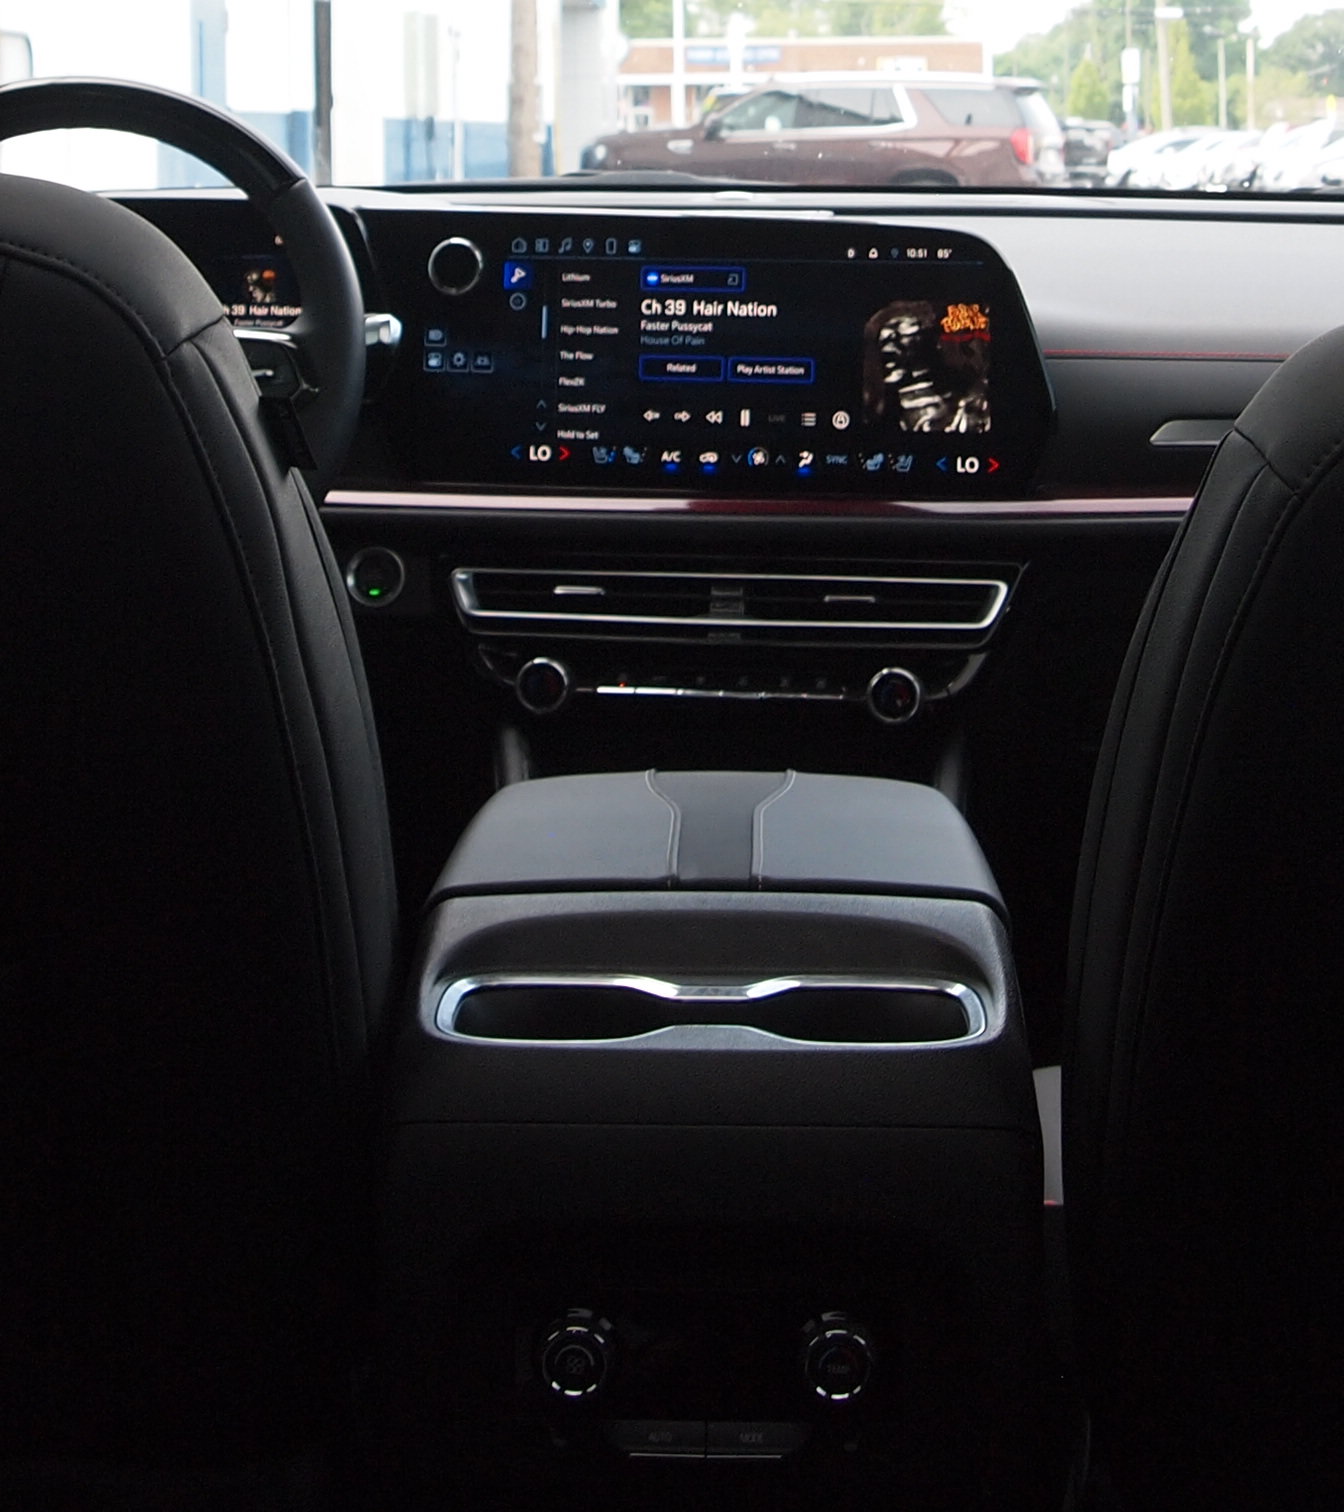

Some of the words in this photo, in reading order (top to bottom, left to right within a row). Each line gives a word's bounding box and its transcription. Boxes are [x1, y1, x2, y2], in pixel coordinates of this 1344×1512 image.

[660, 274, 694, 284] SiriusXM
[561, 298, 595, 308] SiriusXM
[595, 298, 618, 309] Turbo
[640, 298, 662, 316] Ch
[664, 298, 687, 316] 39
[692, 300, 724, 317] Hair
[726, 300, 778, 318] Nation
[230, 304, 247, 316] 39
[248, 305, 269, 316] Hair
[270, 304, 302, 317] Nation
[592, 325, 619, 335] Nation
[640, 319, 670, 331] Faster
[671, 319, 713, 334] Pussycat
[640, 335, 670, 346] House
[671, 335, 683, 346] Of
[684, 334, 706, 346] Pain
[559, 350, 575, 361] The
[574, 350, 594, 361] Flow
[666, 362, 697, 373] Related
[736, 364, 754, 376] Play
[753, 364, 776, 375] Artist
[776, 365, 805, 375] Station
[557, 402, 592, 413] SiriusXM
[556, 429, 577, 440] Hold
[576, 431, 585, 440] to
[586, 430, 598, 440] Set
[529, 444, 552, 462] LO
[660, 449, 682, 464] A/C
[826, 454, 848, 465] SYNC
[956, 456, 980, 474] LO
